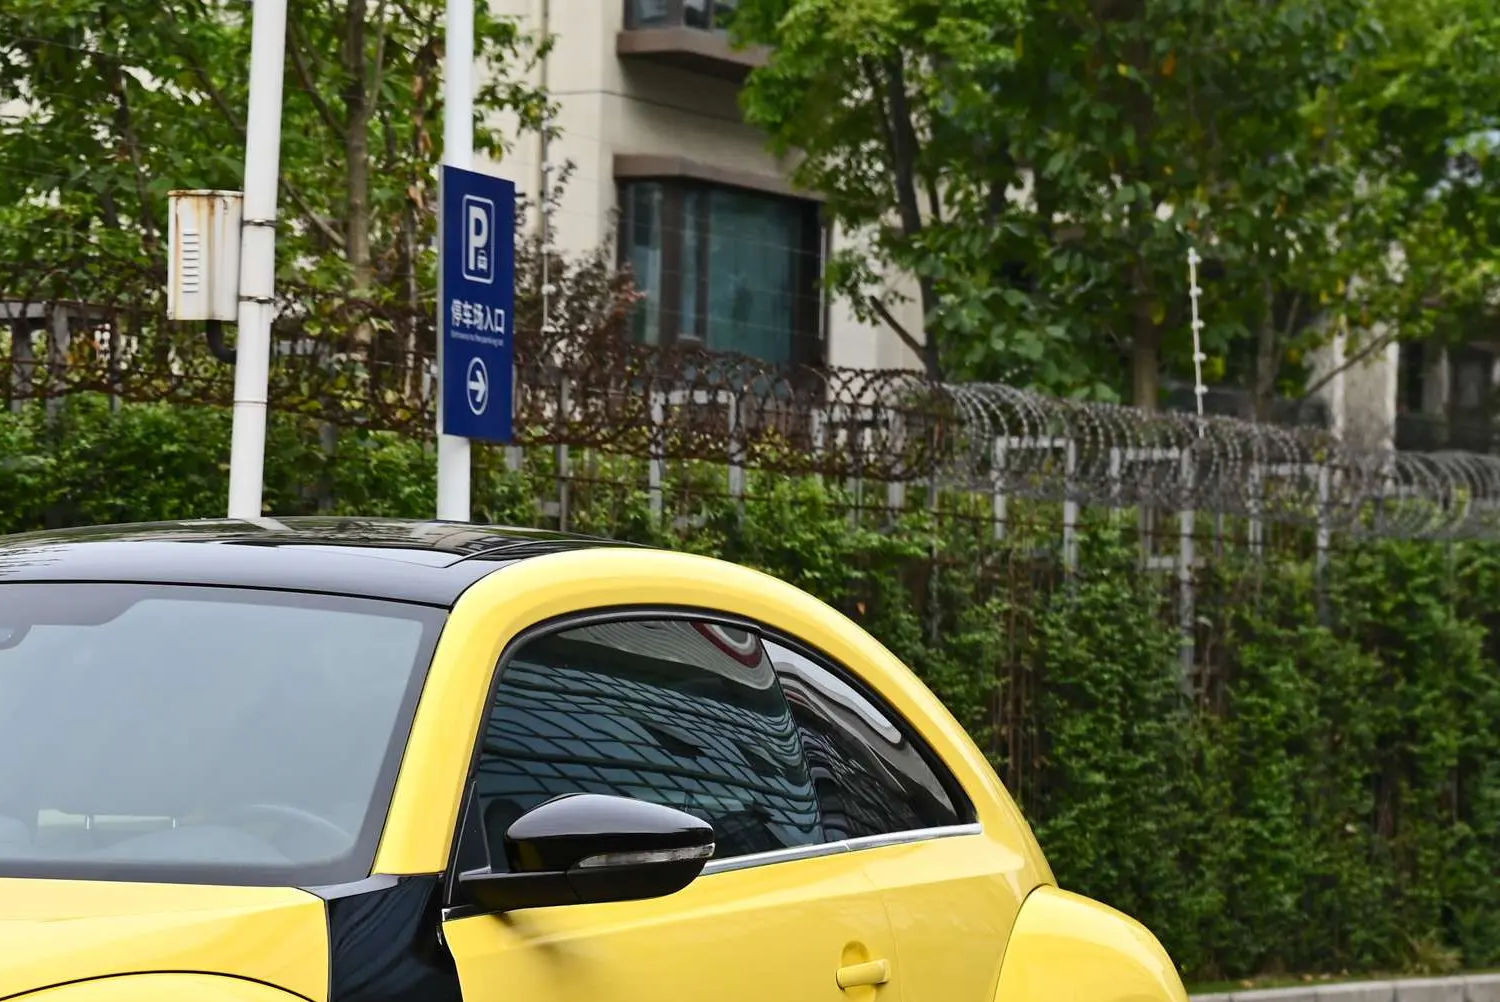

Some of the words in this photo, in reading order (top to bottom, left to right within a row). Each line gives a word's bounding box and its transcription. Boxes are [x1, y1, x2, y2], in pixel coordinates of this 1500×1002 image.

[468, 205, 488, 271] P
[451, 299, 505, 334] 停车场入口
